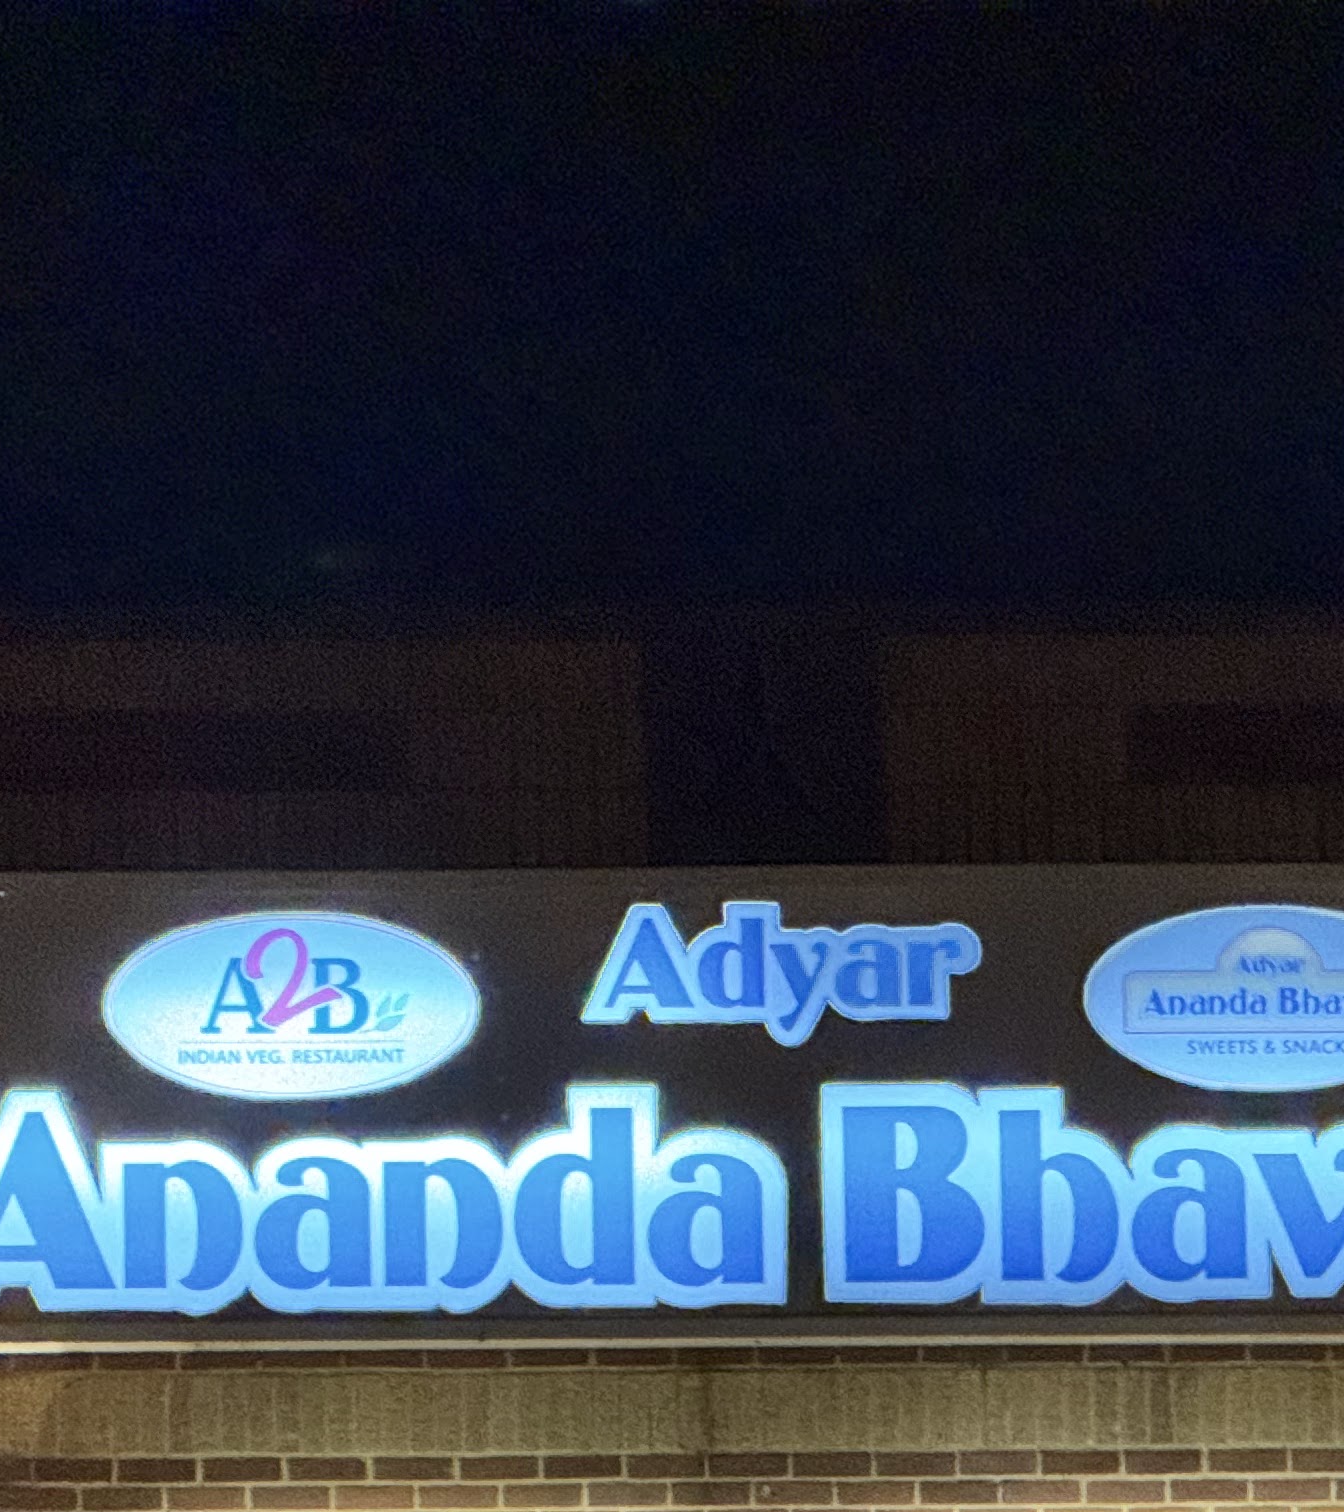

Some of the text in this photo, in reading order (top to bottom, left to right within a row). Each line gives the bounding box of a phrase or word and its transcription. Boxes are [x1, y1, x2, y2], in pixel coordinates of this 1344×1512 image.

[199, 927, 370, 1035] A2B
[598, 912, 967, 1038] Adyar
[1144, 986, 1268, 1016] Ananda
[177, 1048, 405, 1065] INDIAN VEG. RESTAURANT
[1186, 1039, 1257, 1056] SWEETS
[1264, 1040, 1277, 1055] &
